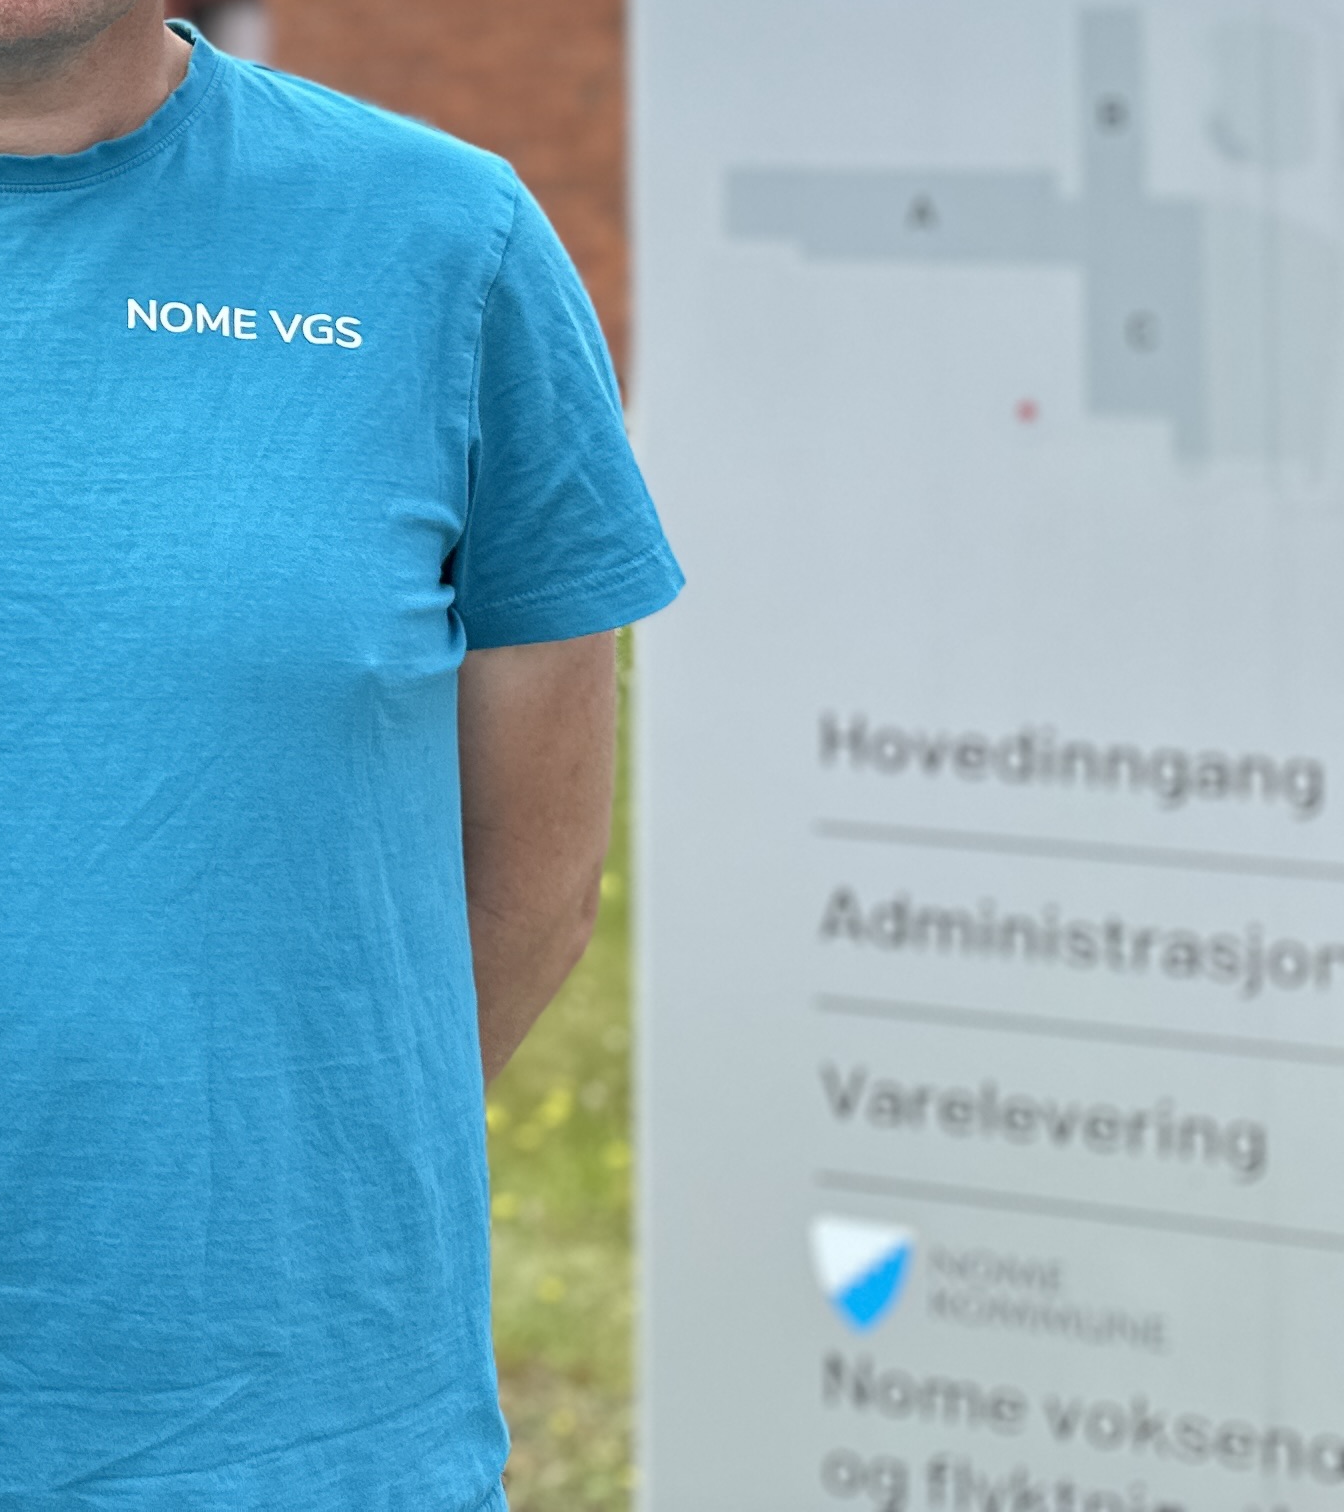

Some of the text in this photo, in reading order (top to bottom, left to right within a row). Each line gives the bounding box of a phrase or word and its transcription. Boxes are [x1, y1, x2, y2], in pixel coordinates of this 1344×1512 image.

[126, 298, 363, 349] NOME VGS
[817, 710, 1325, 822] Hovedinngang
[818, 1061, 1267, 1186] Varelevering
[820, 1347, 1028, 1436] Nome
